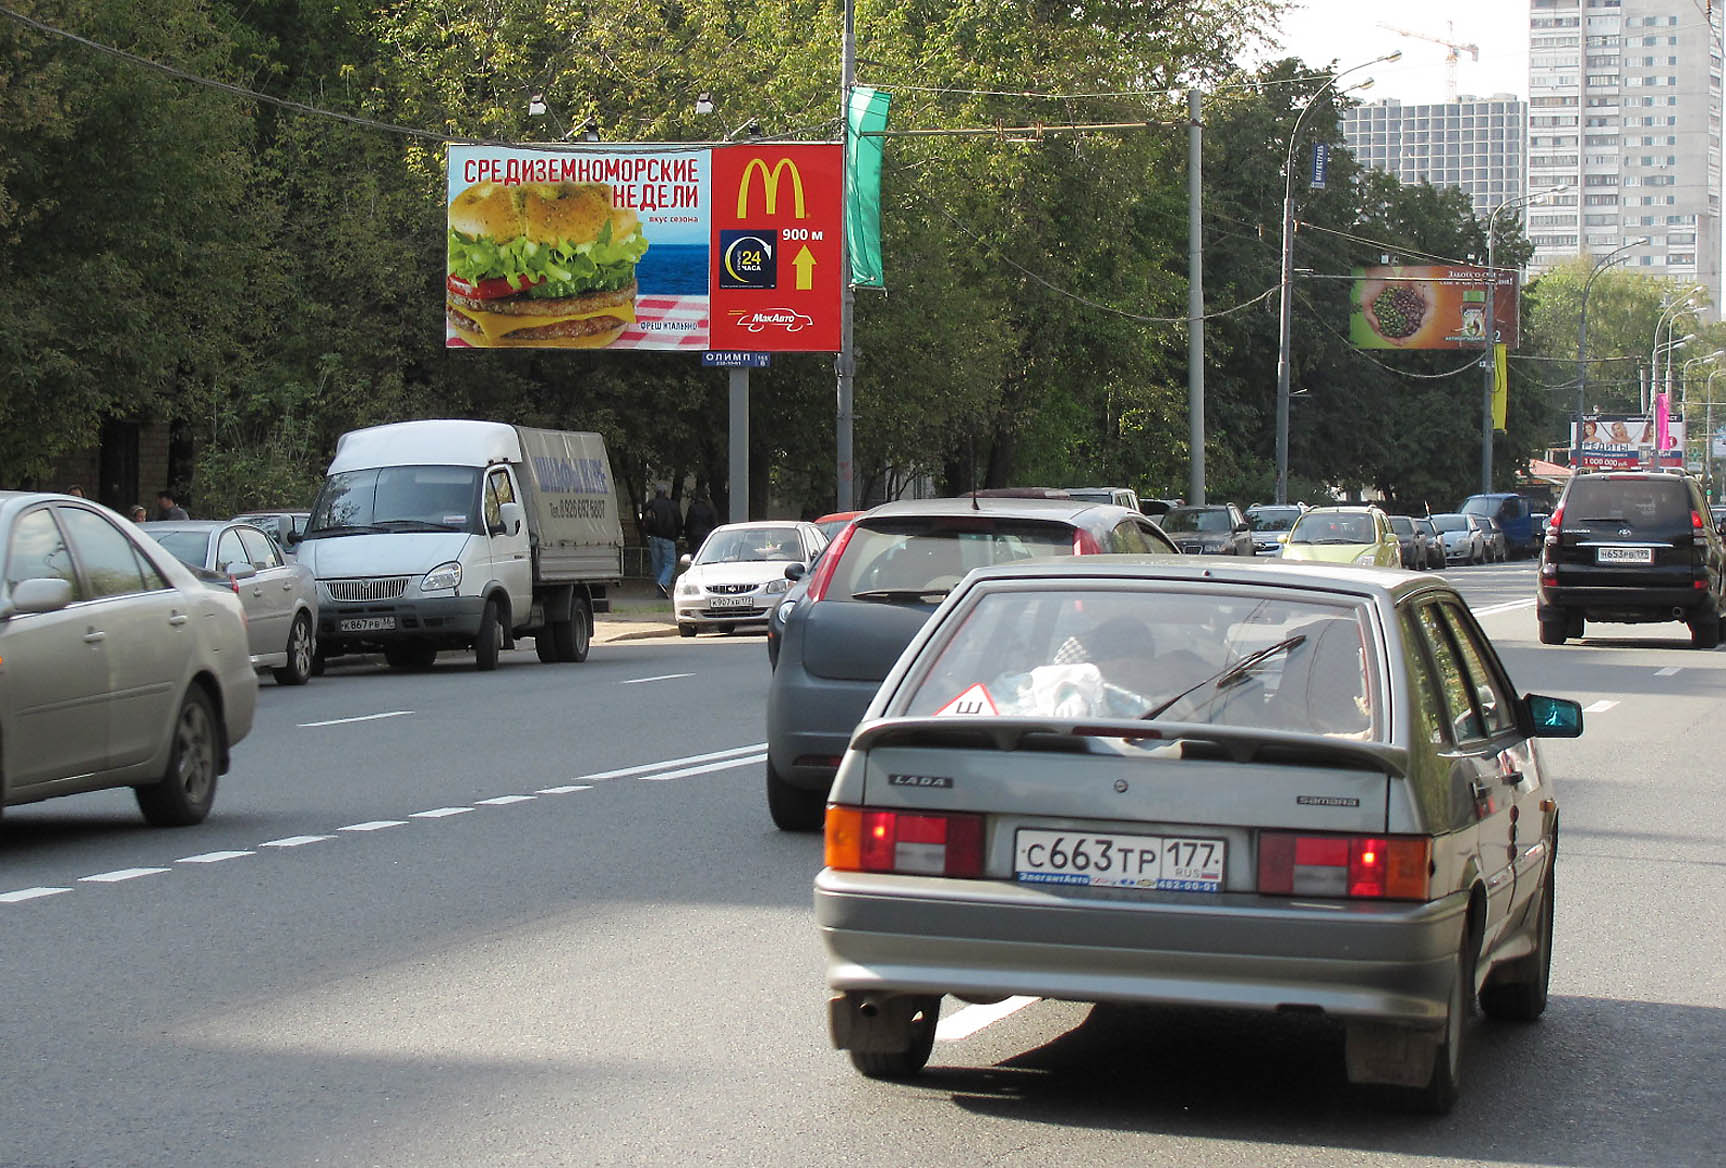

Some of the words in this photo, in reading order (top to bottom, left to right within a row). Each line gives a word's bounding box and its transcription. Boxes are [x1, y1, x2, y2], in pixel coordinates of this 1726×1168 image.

[464, 158, 699, 186] СРЕДИЗЕМНОМОРСКИЕ
[613, 184, 699, 212] НЕДЕЛИ
[649, 216, 668, 224] вкус
[782, 228, 809, 241] 900
[742, 250, 762, 265] 24
[752, 313, 795, 323] МакАвто
[640, 321, 662, 330] ФРЕШ
[705, 353, 751, 361] ОЛИМП
[956, 701, 983, 714] Ш
[895, 775, 945, 786] LADA
[1167, 842, 1215, 868] 177
[1175, 868, 1200, 878] RUS
